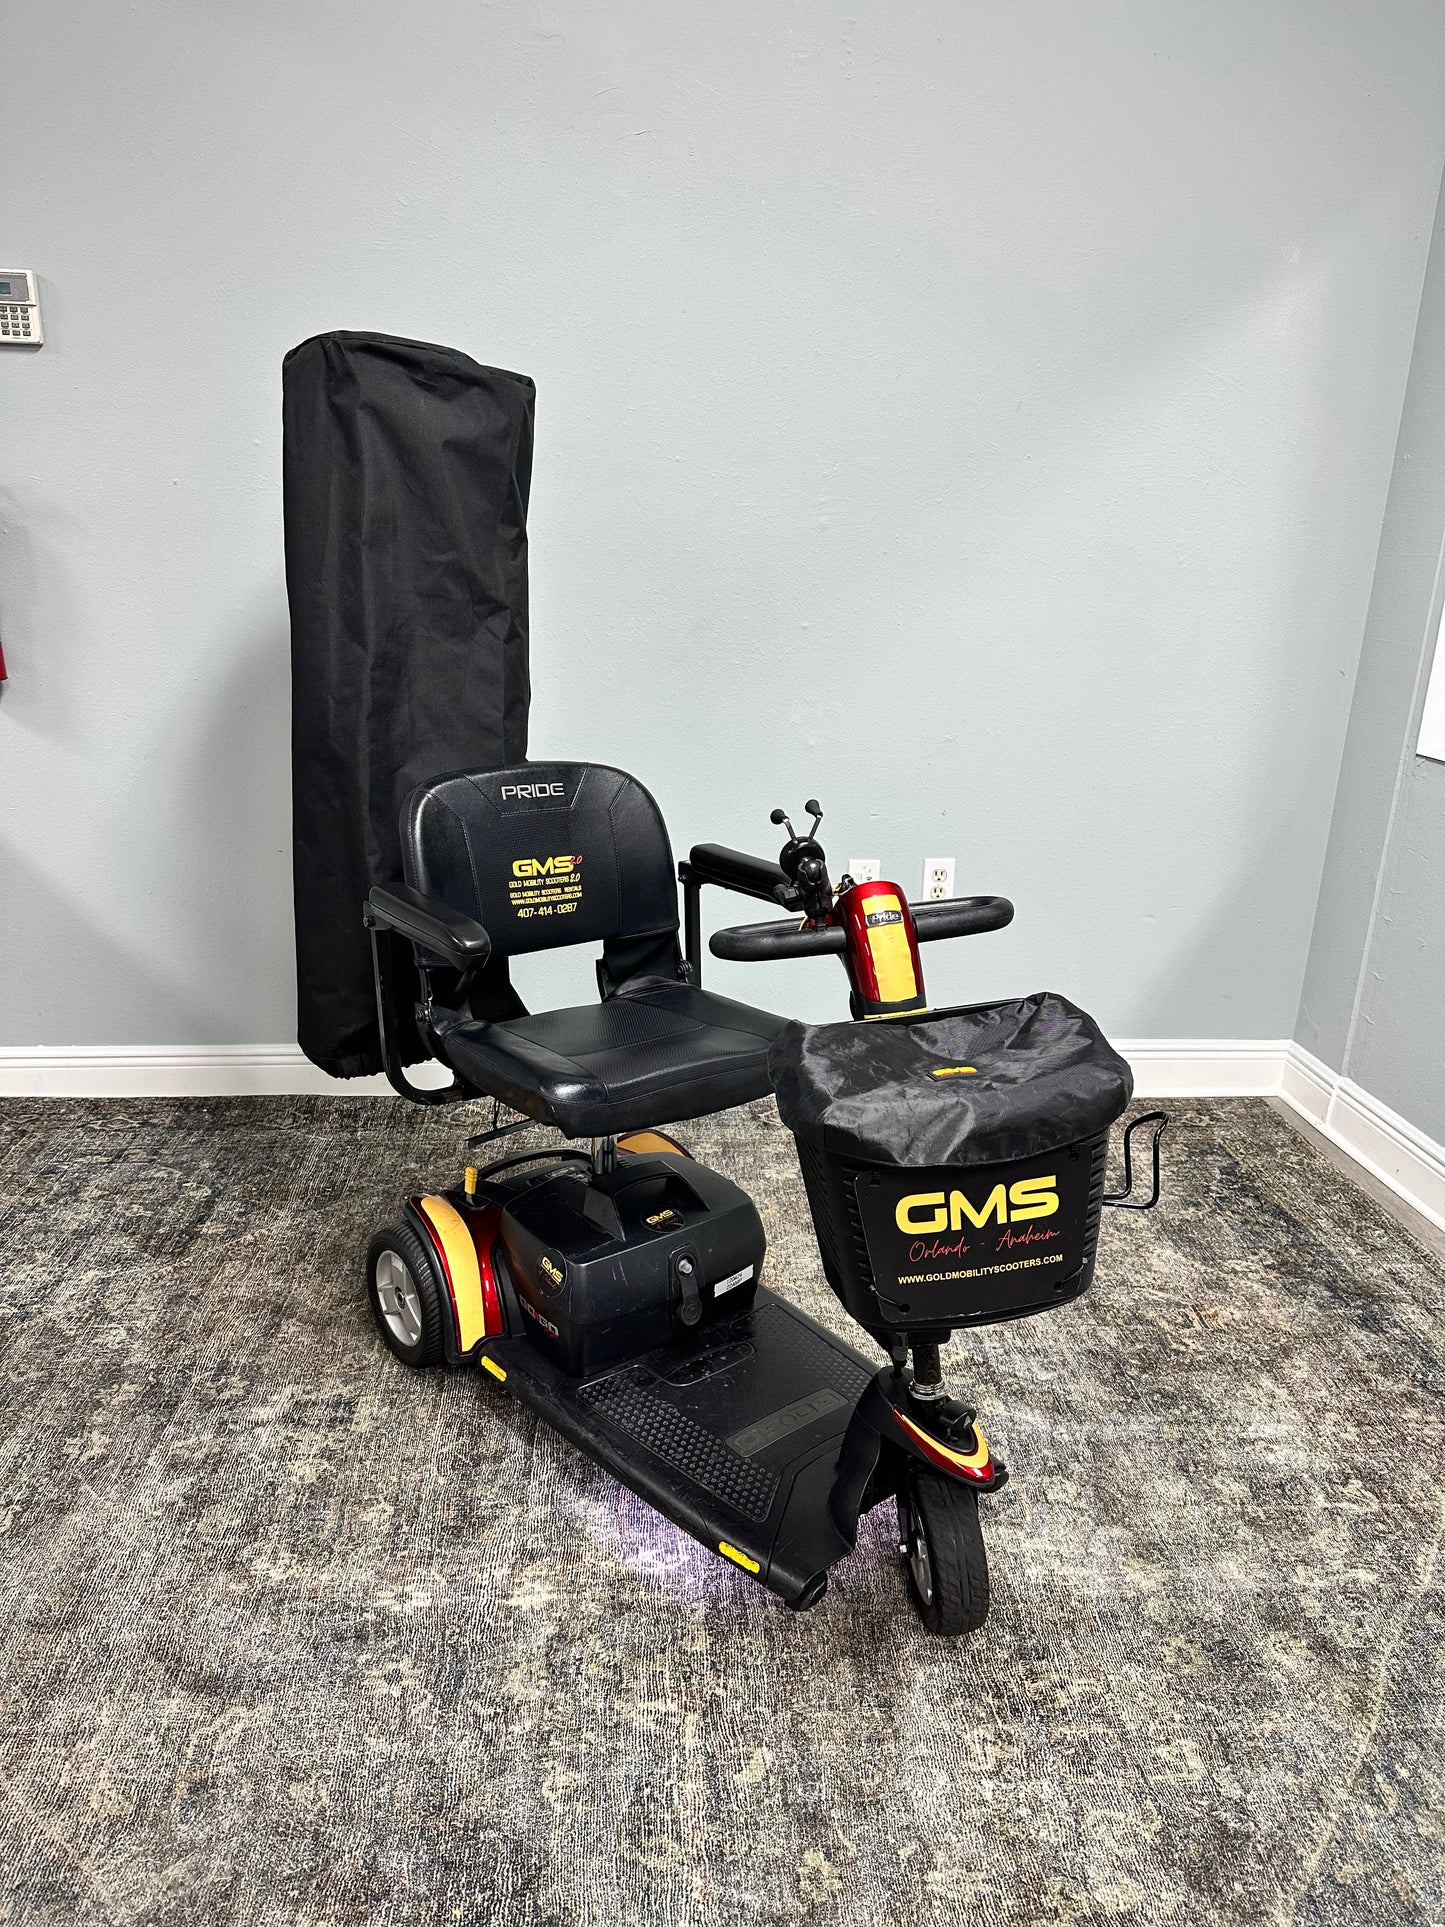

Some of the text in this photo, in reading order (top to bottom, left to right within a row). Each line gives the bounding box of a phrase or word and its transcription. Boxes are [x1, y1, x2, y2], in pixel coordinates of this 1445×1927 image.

[501, 783, 565, 800] PRIDE
[512, 856, 574, 877] GMS
[645, 1209, 674, 1224] GMS
[895, 1174, 1060, 1235] GMS
[908, 1235, 971, 1263] Orlando
[995, 1224, 1061, 1252] Anaheim
[541, 1256, 564, 1283] GMS
[897, 1253, 1064, 1285] WWW.GOLDMOBILITYSCOOTERS.COM
